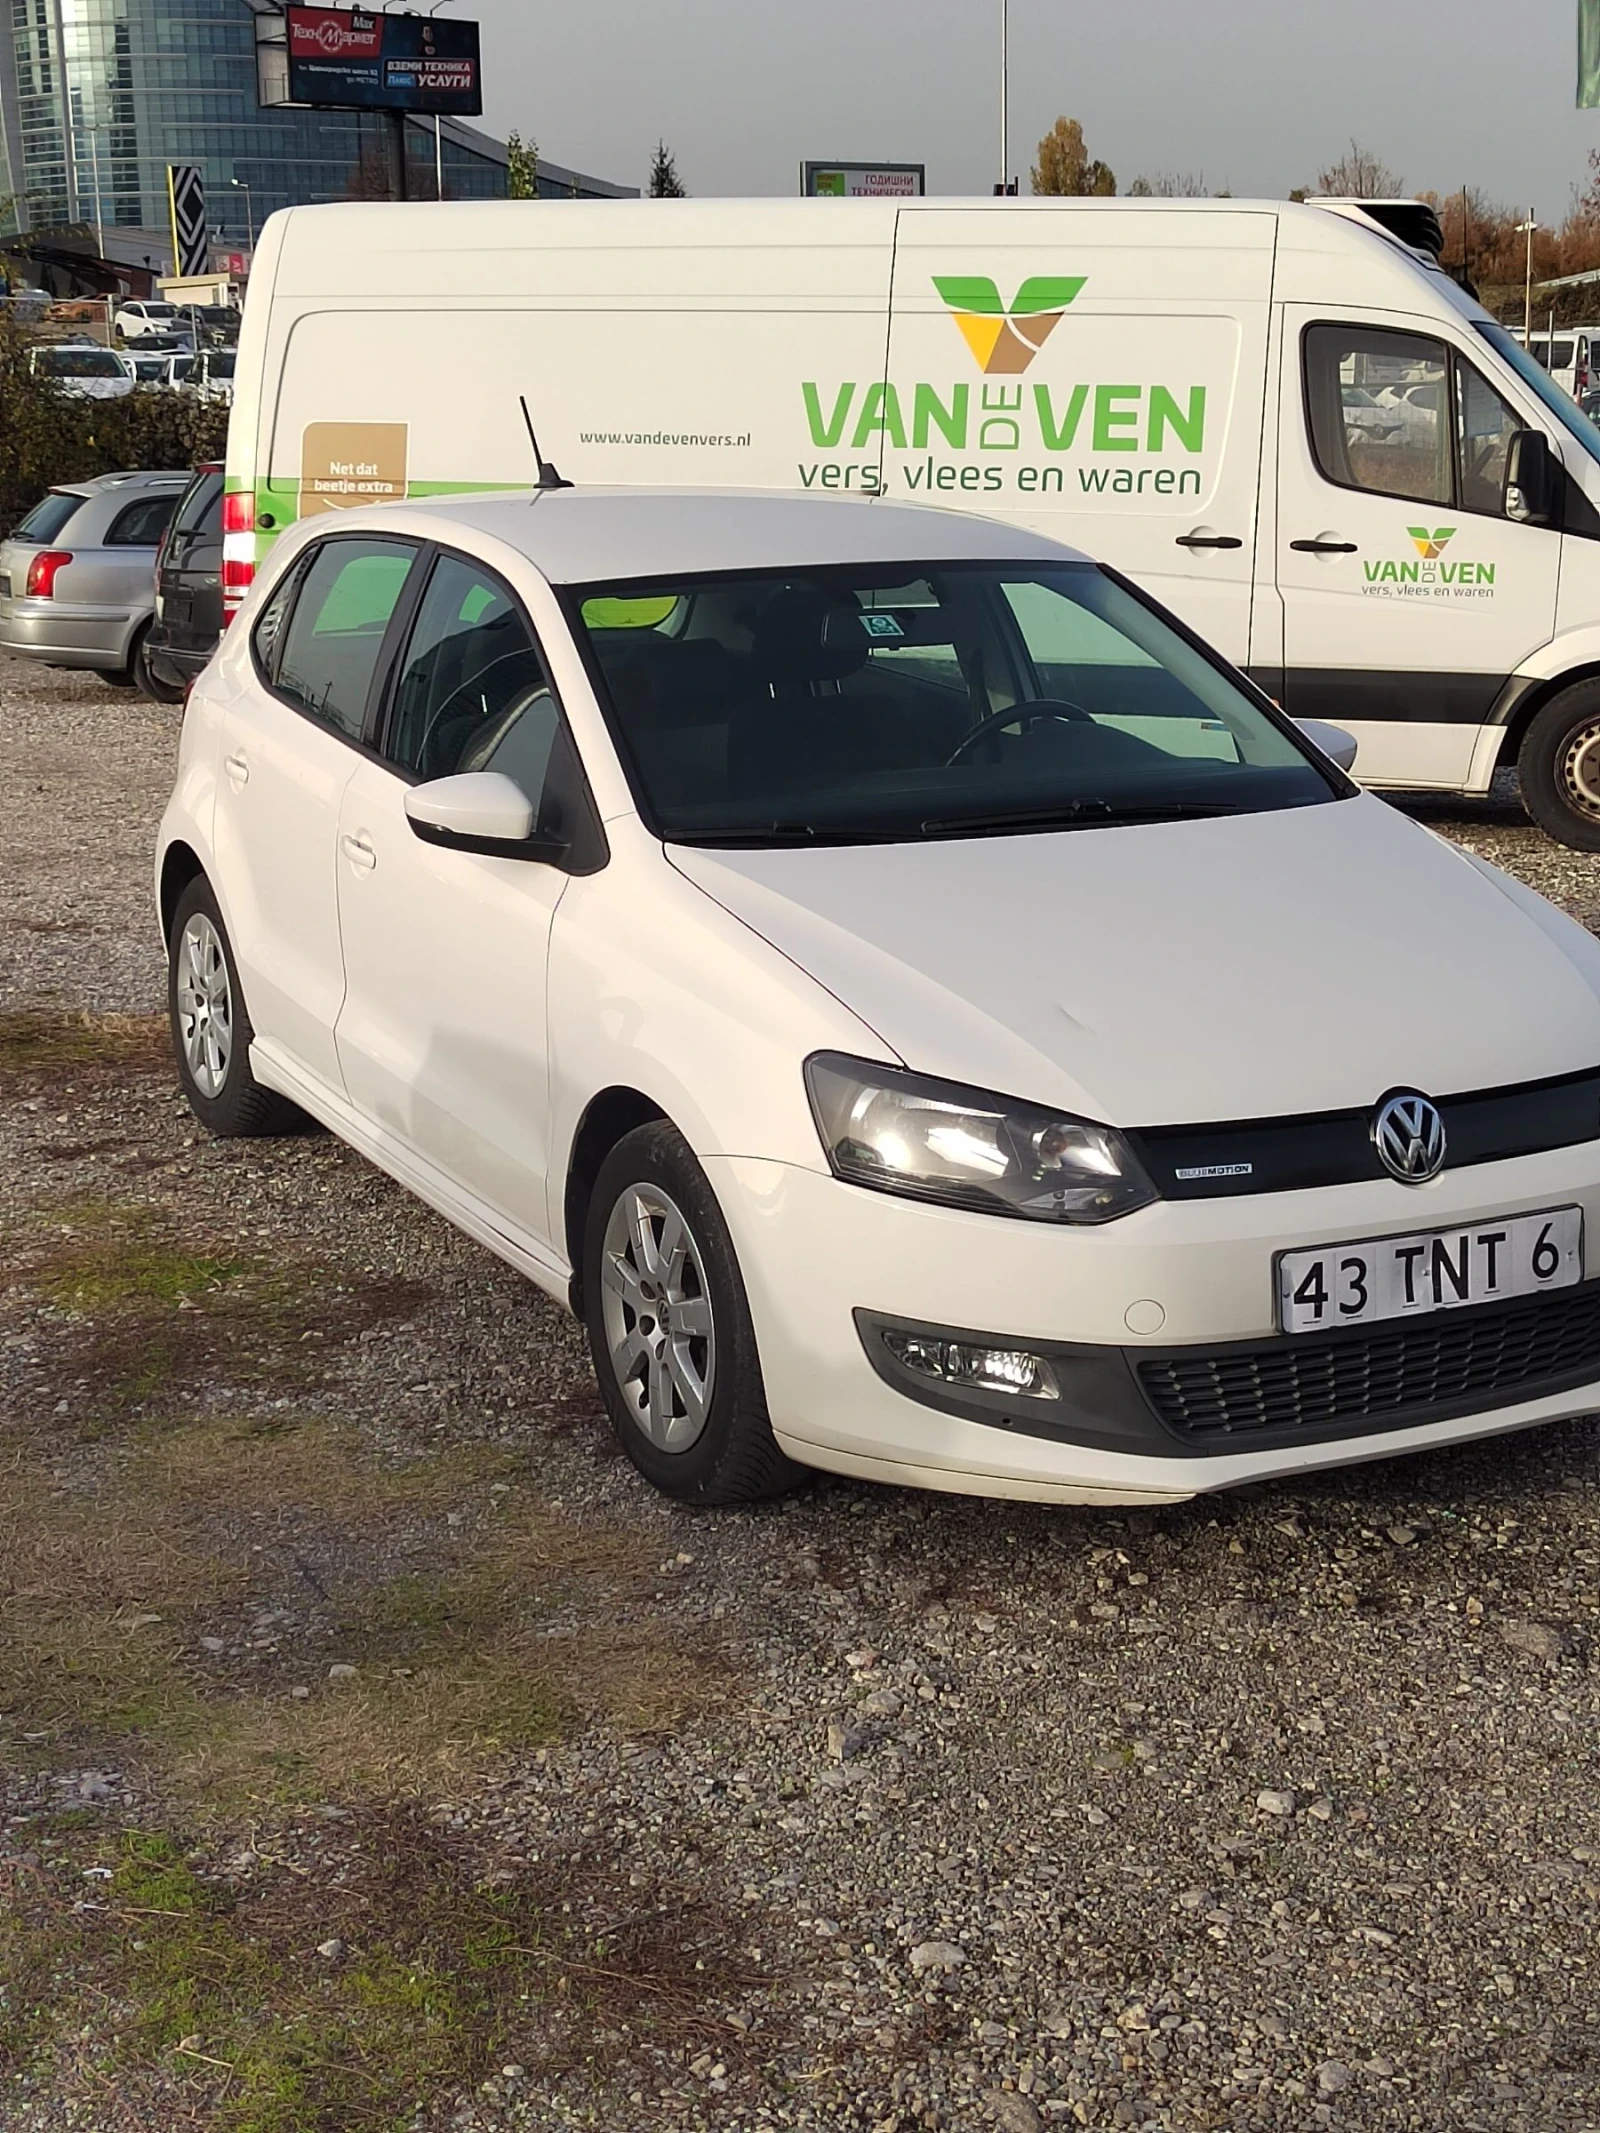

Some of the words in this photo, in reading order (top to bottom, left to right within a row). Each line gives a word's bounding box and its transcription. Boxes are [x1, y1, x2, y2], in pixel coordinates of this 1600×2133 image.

[353, 16, 374, 30] Max
[387, 61, 422, 71] ВЗЕМИ
[424, 62, 471, 72] ТЕХНИКА
[418, 74, 471, 87] УСЛУГИ
[865, 174, 914, 186] ГОДИШНИ
[801, 382, 970, 450] VAN
[1033, 384, 1207, 453] VEN
[579, 430, 752, 447] www.vandevenvers.nl
[330, 461, 354, 475] Net
[356, 462, 378, 476] dat
[797, 463, 889, 497] vers,
[902, 455, 1003, 491] vlees
[1017, 466, 1063, 493] en
[1078, 468, 1201, 495] waren
[314, 479, 356, 494] beetje
[357, 481, 393, 493] extra
[1363, 560, 1419, 583] VAN
[1439, 562, 1496, 584] VEN
[1361, 584, 1393, 598] vers,
[1396, 584, 1430, 597] vlees
[1433, 587, 1450, 598] en
[1453, 588, 1494, 598] waren
[1180, 1165, 1249, 1178] BLUEMOTION
[1293, 1257, 1368, 1319] 43
[1395, 1231, 1506, 1304] TNT
[1531, 1222, 1559, 1279] 6
